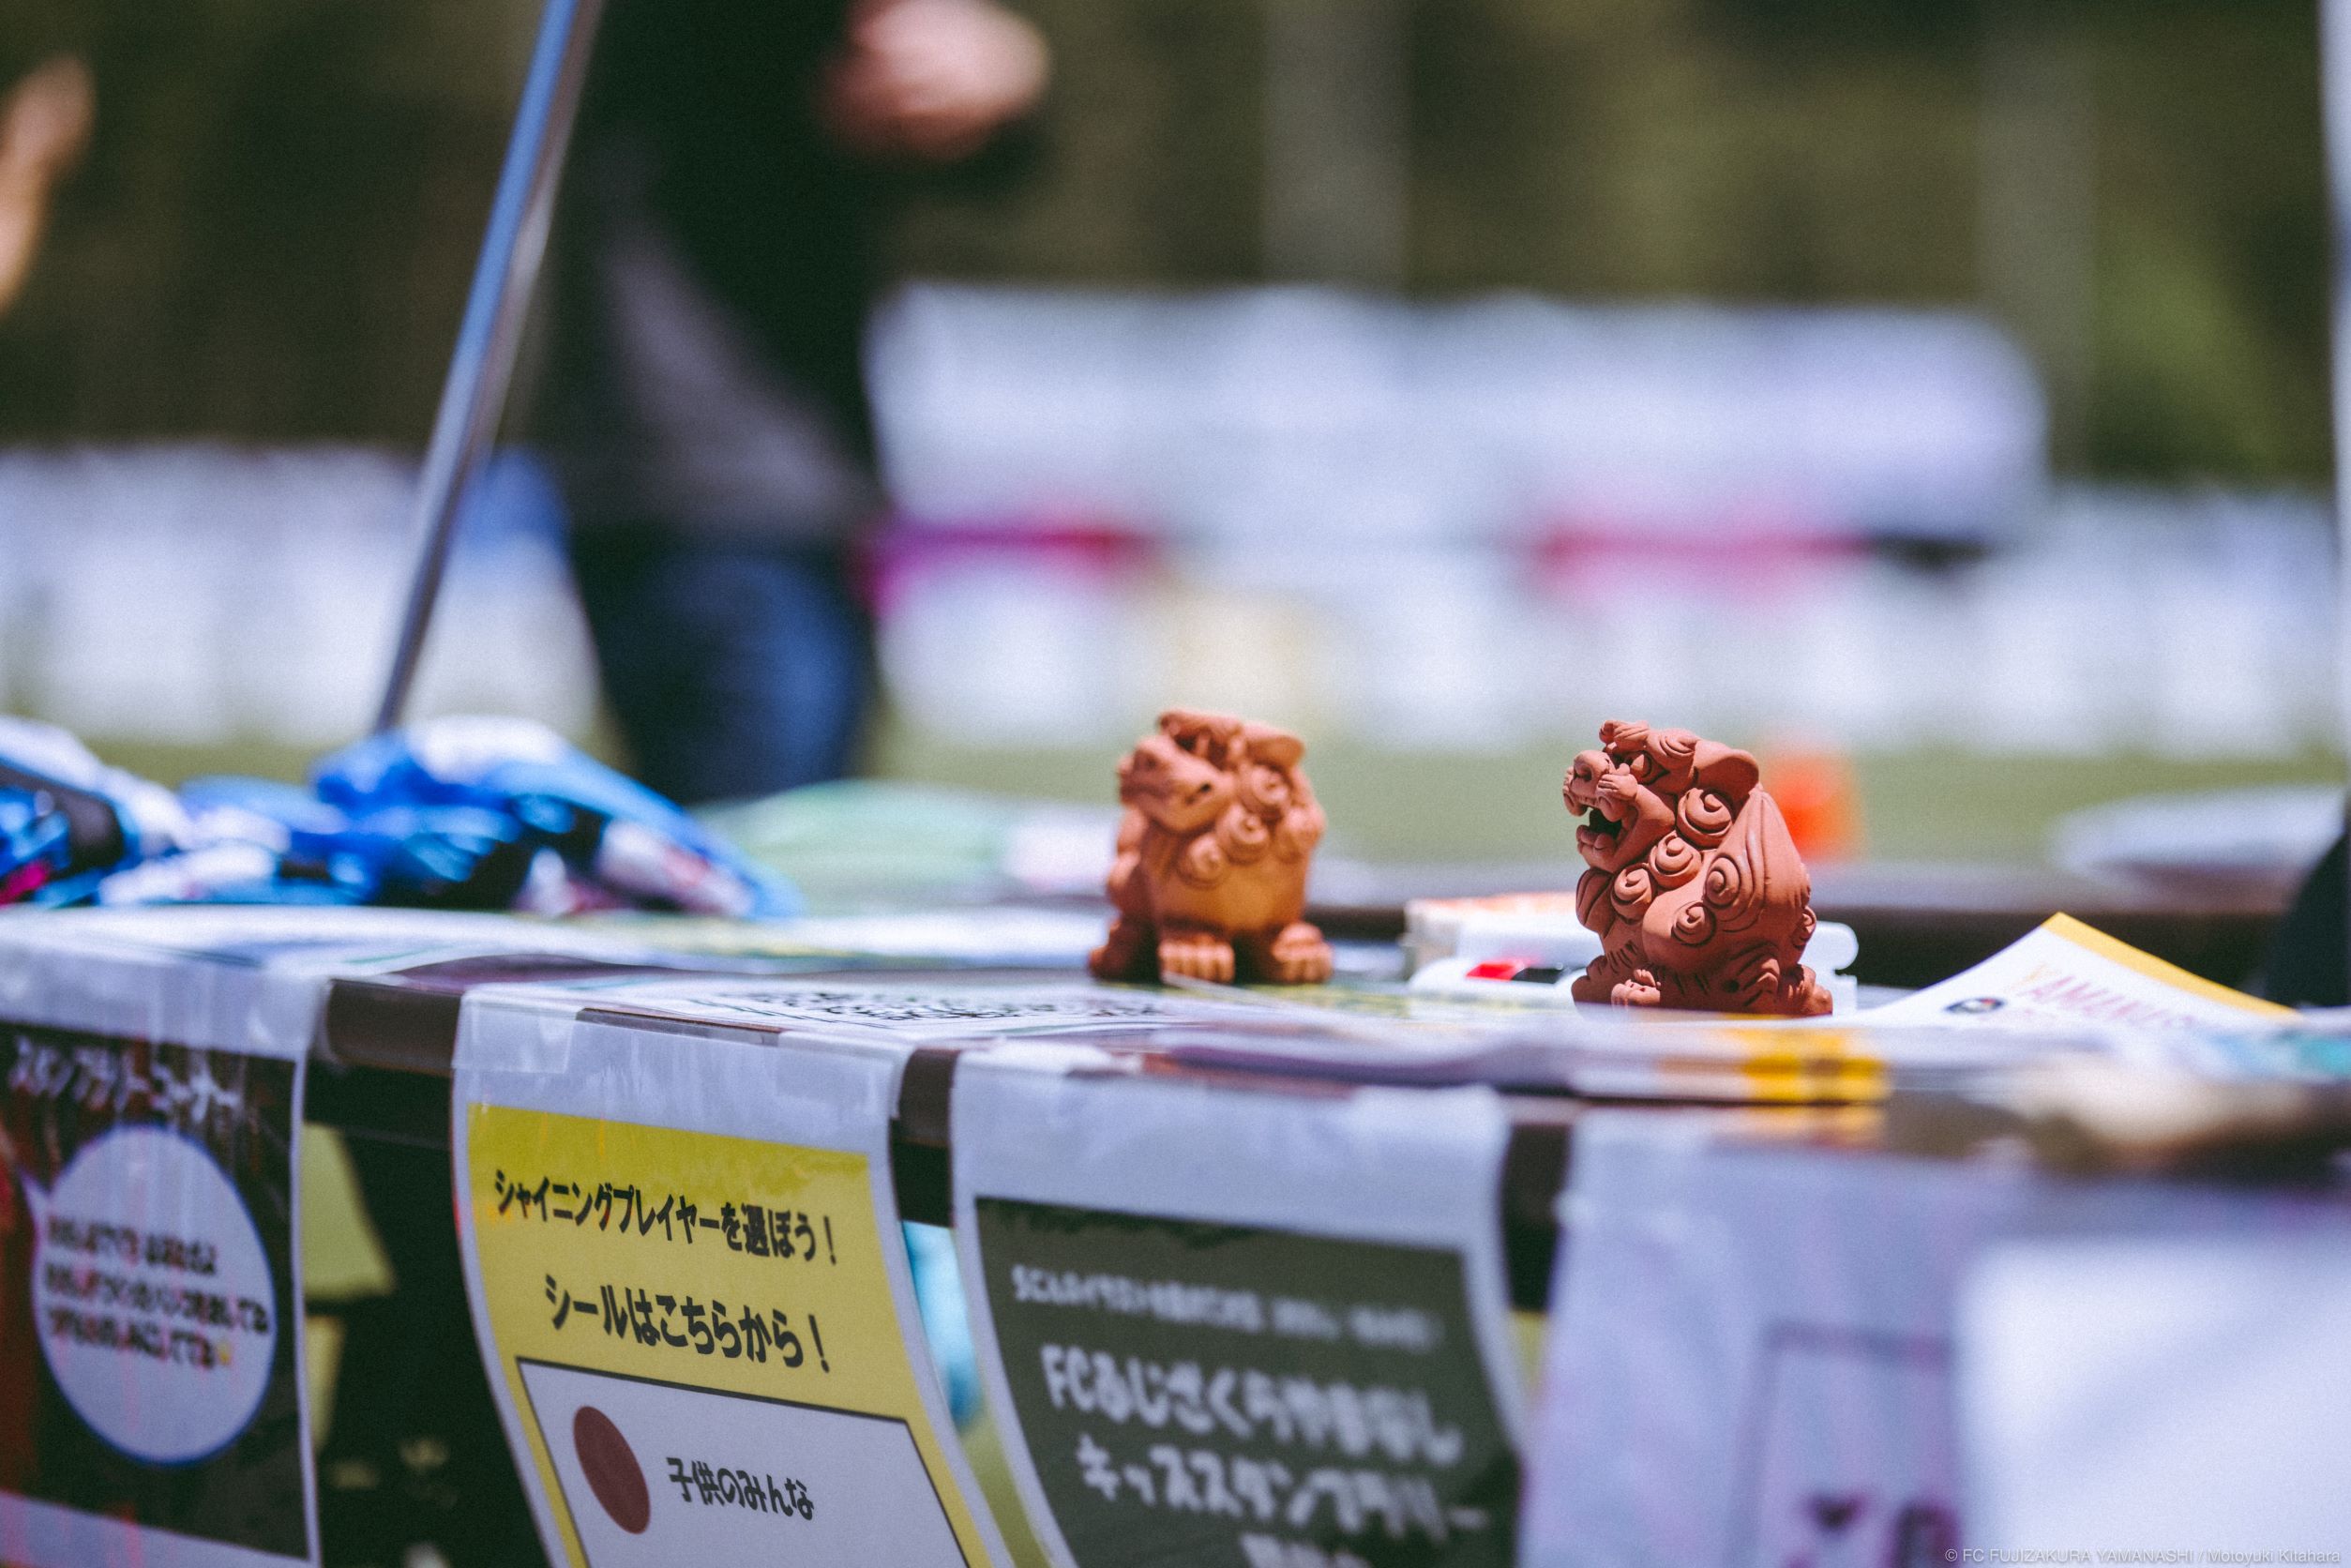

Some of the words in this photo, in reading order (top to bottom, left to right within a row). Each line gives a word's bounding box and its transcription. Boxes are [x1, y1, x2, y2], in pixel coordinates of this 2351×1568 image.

[495, 1169, 836, 1265] シャイニングプレイヤーを選ぼう！
[545, 1274, 830, 1373] シールはこちらから！
[667, 1457, 814, 1520] 子供のみんな
